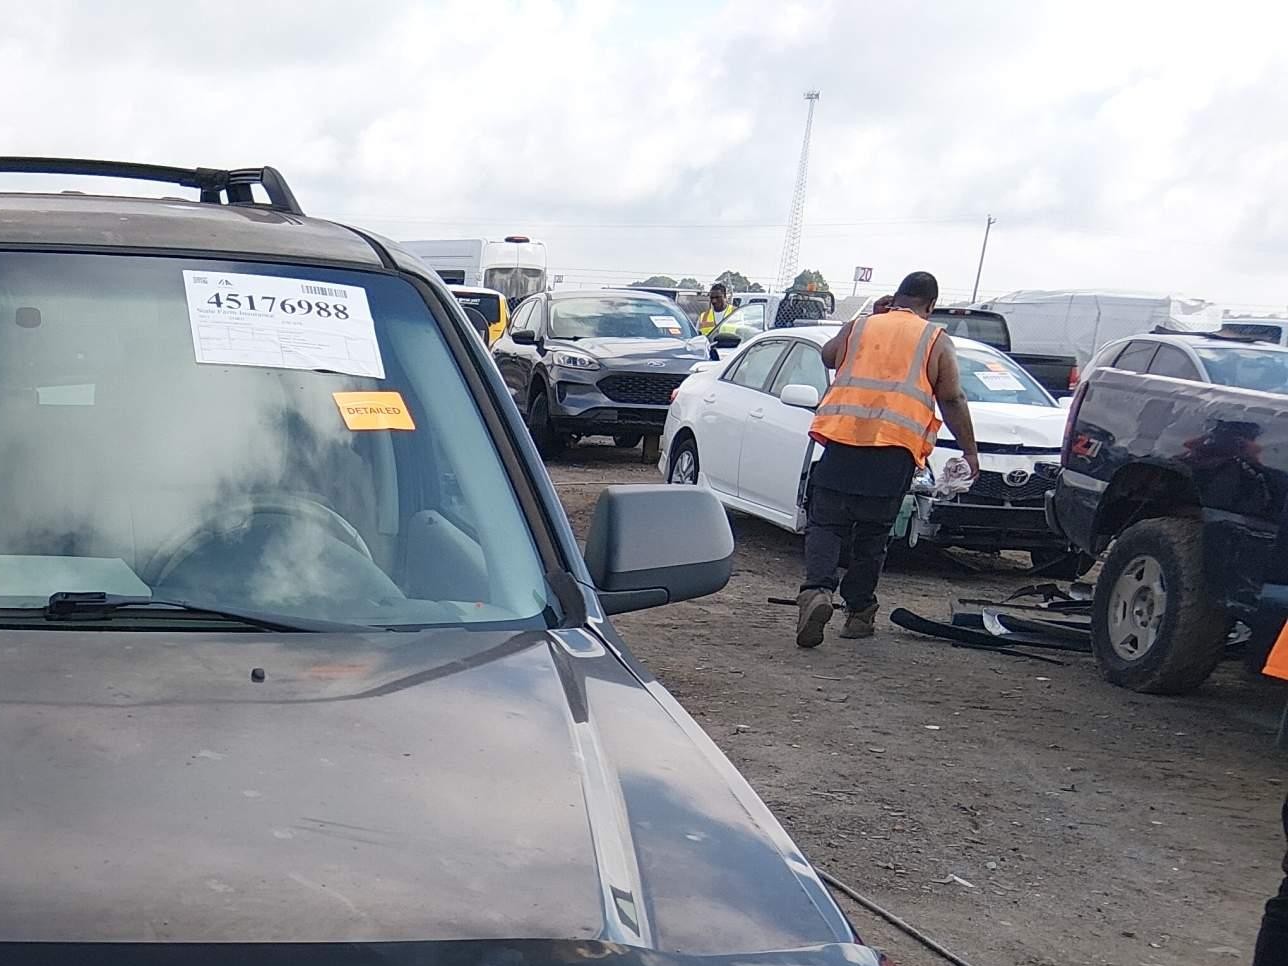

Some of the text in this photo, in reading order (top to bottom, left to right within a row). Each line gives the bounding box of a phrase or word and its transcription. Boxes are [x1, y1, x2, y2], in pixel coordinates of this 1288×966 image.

[858, 267, 873, 282] 20
[207, 292, 350, 320] 45176988
[346, 406, 401, 416] DETAILED
